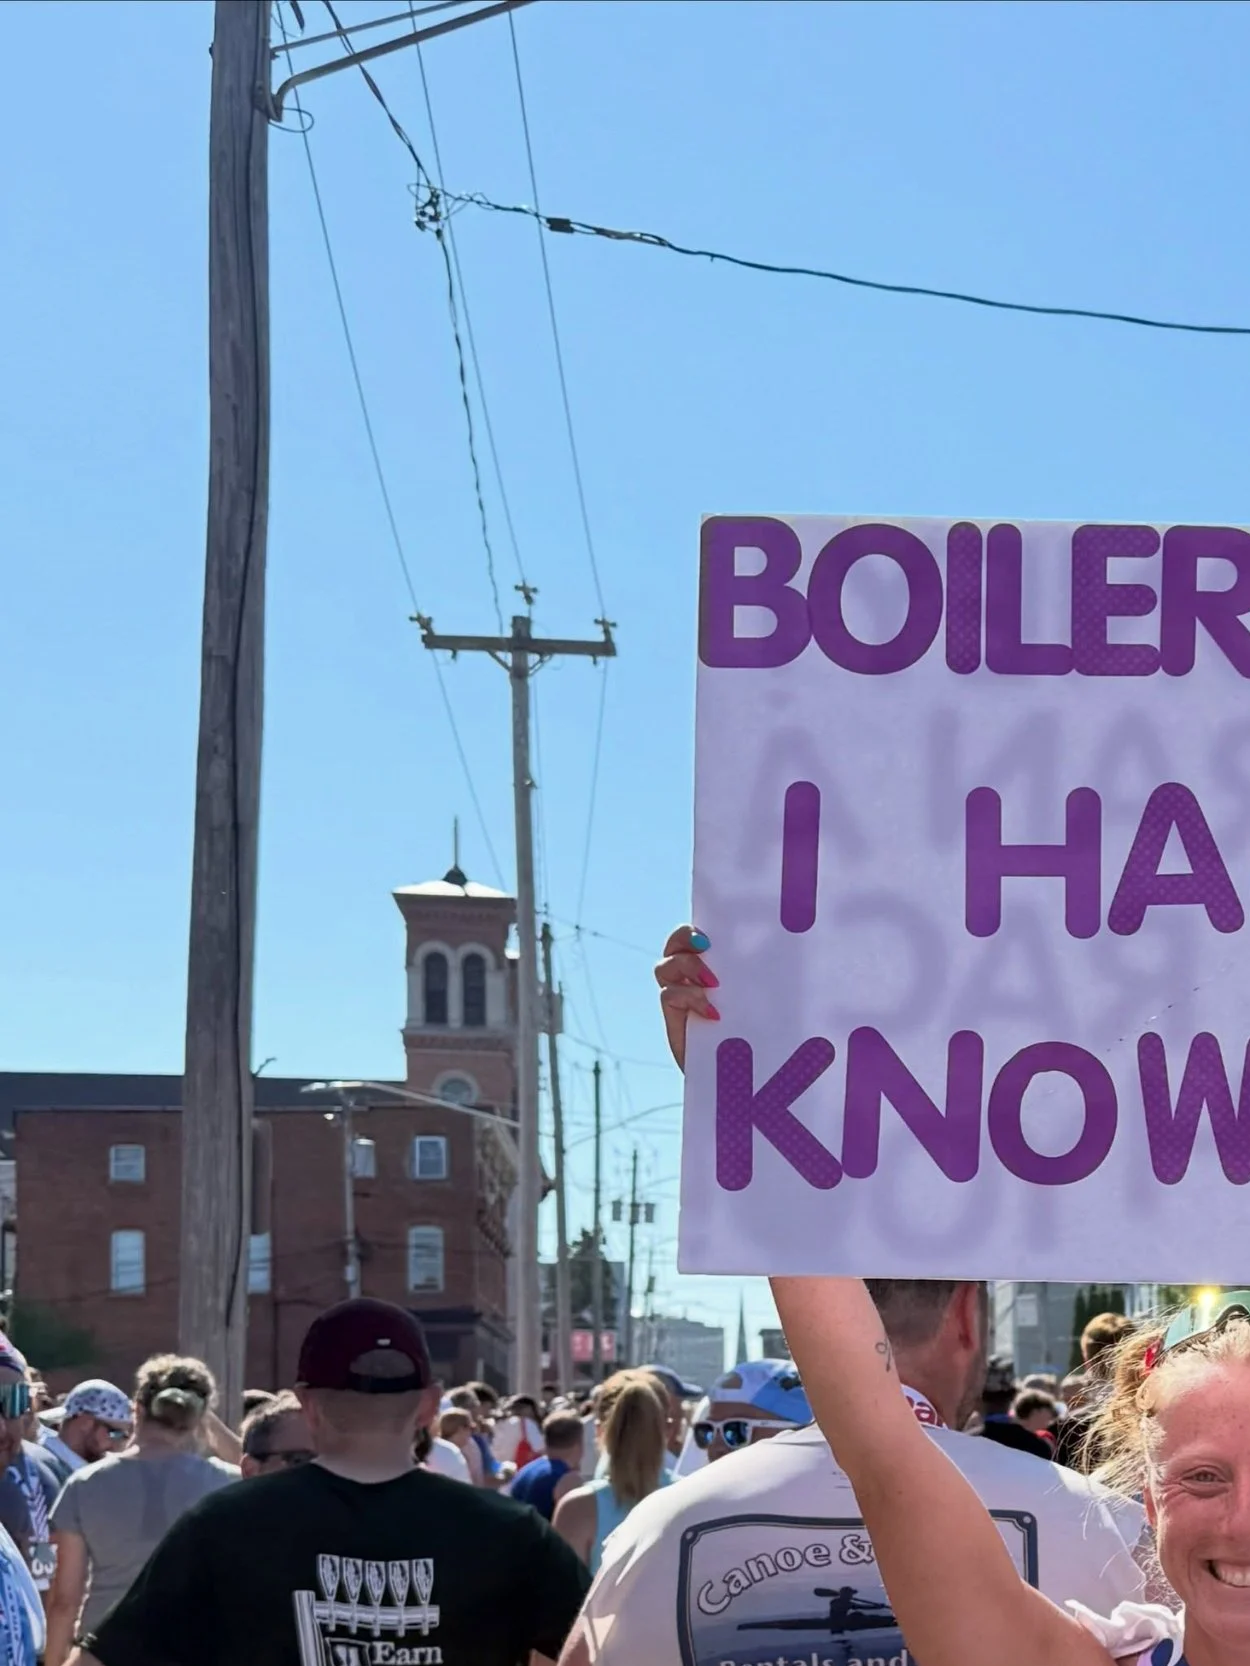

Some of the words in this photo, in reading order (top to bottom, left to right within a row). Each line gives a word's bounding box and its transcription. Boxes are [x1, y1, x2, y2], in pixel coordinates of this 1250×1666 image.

[780, 781, 820, 932] I
[697, 1543, 830, 1615] Canoe
[371, 1641, 444, 1665] Earn
